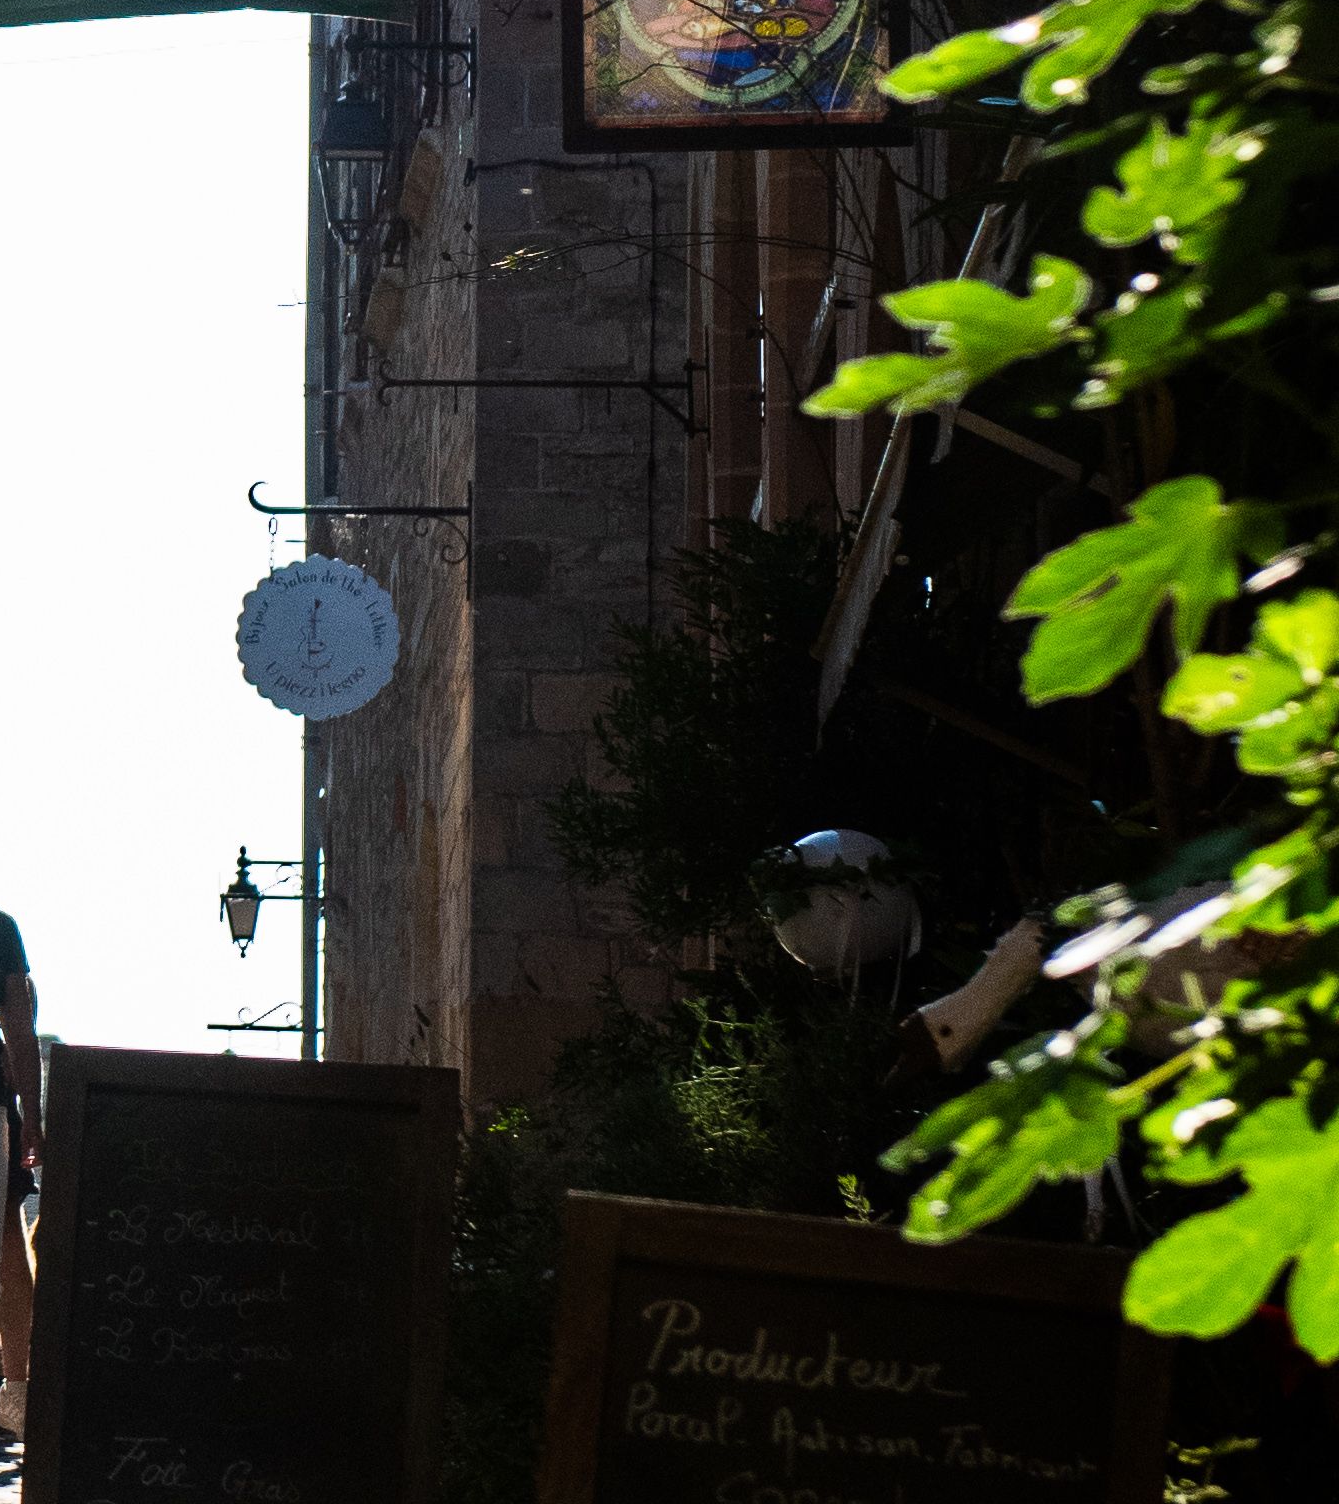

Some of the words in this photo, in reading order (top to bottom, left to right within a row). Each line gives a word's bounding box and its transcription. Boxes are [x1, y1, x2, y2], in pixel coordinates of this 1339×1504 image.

[640, 1297, 969, 1399] Producteur
[107, 1435, 196, 1488] Foie
[220, 1459, 302, 1503] Gras
